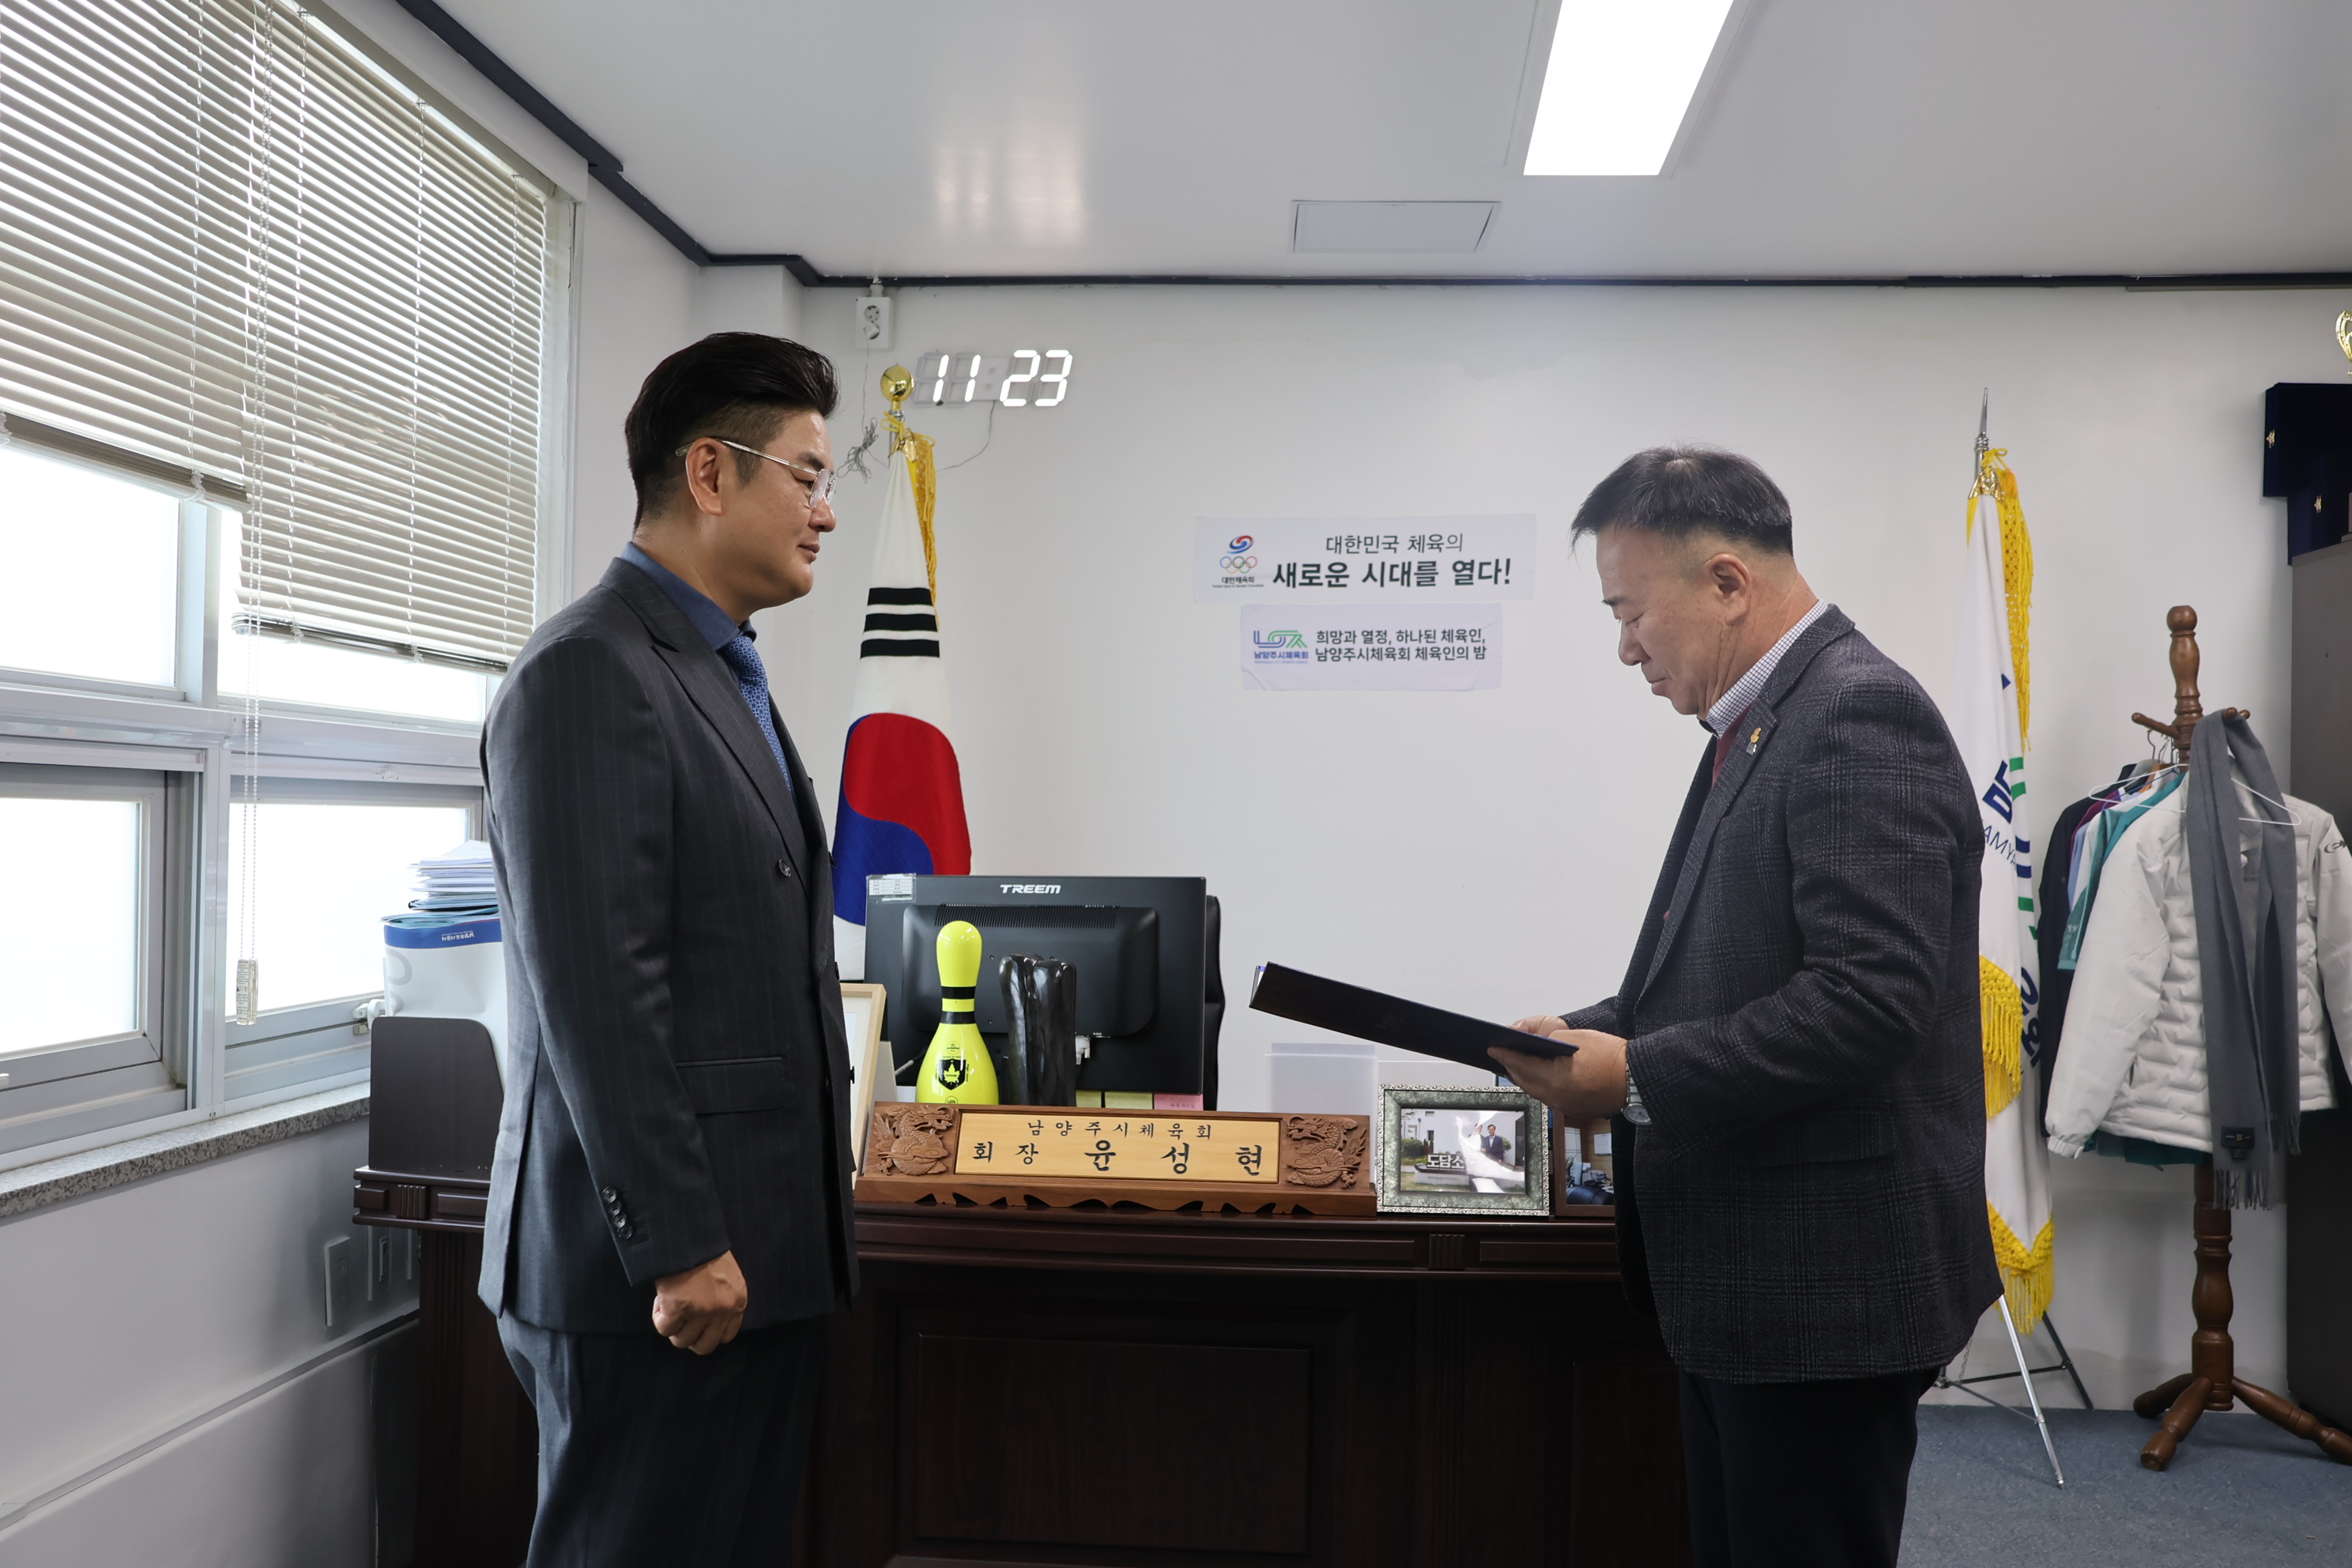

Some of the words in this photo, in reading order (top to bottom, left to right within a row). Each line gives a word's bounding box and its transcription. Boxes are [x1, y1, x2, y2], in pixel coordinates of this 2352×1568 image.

[1326, 535, 1400, 555] 대한민국
[1408, 533, 1464, 554] 체육의
[1272, 562, 1350, 589] 새로운
[1361, 560, 1439, 588] 시대를
[1452, 558, 1511, 586] 열다!
[1316, 630, 1357, 645] 희망과
[1361, 630, 1392, 646] 열정,
[1396, 629, 1436, 645] 하나된
[1441, 628, 1486, 645] 체육인,
[1253, 650, 1309, 660] 남양주시체육회
[1315, 646, 1410, 662] 남양주시체육회
[1415, 646, 1469, 662] 체육인의
[1473, 645, 1487, 661] 밤
[999, 884, 1062, 895] TREEM
[1427, 1154, 1465, 1169] 도담소
